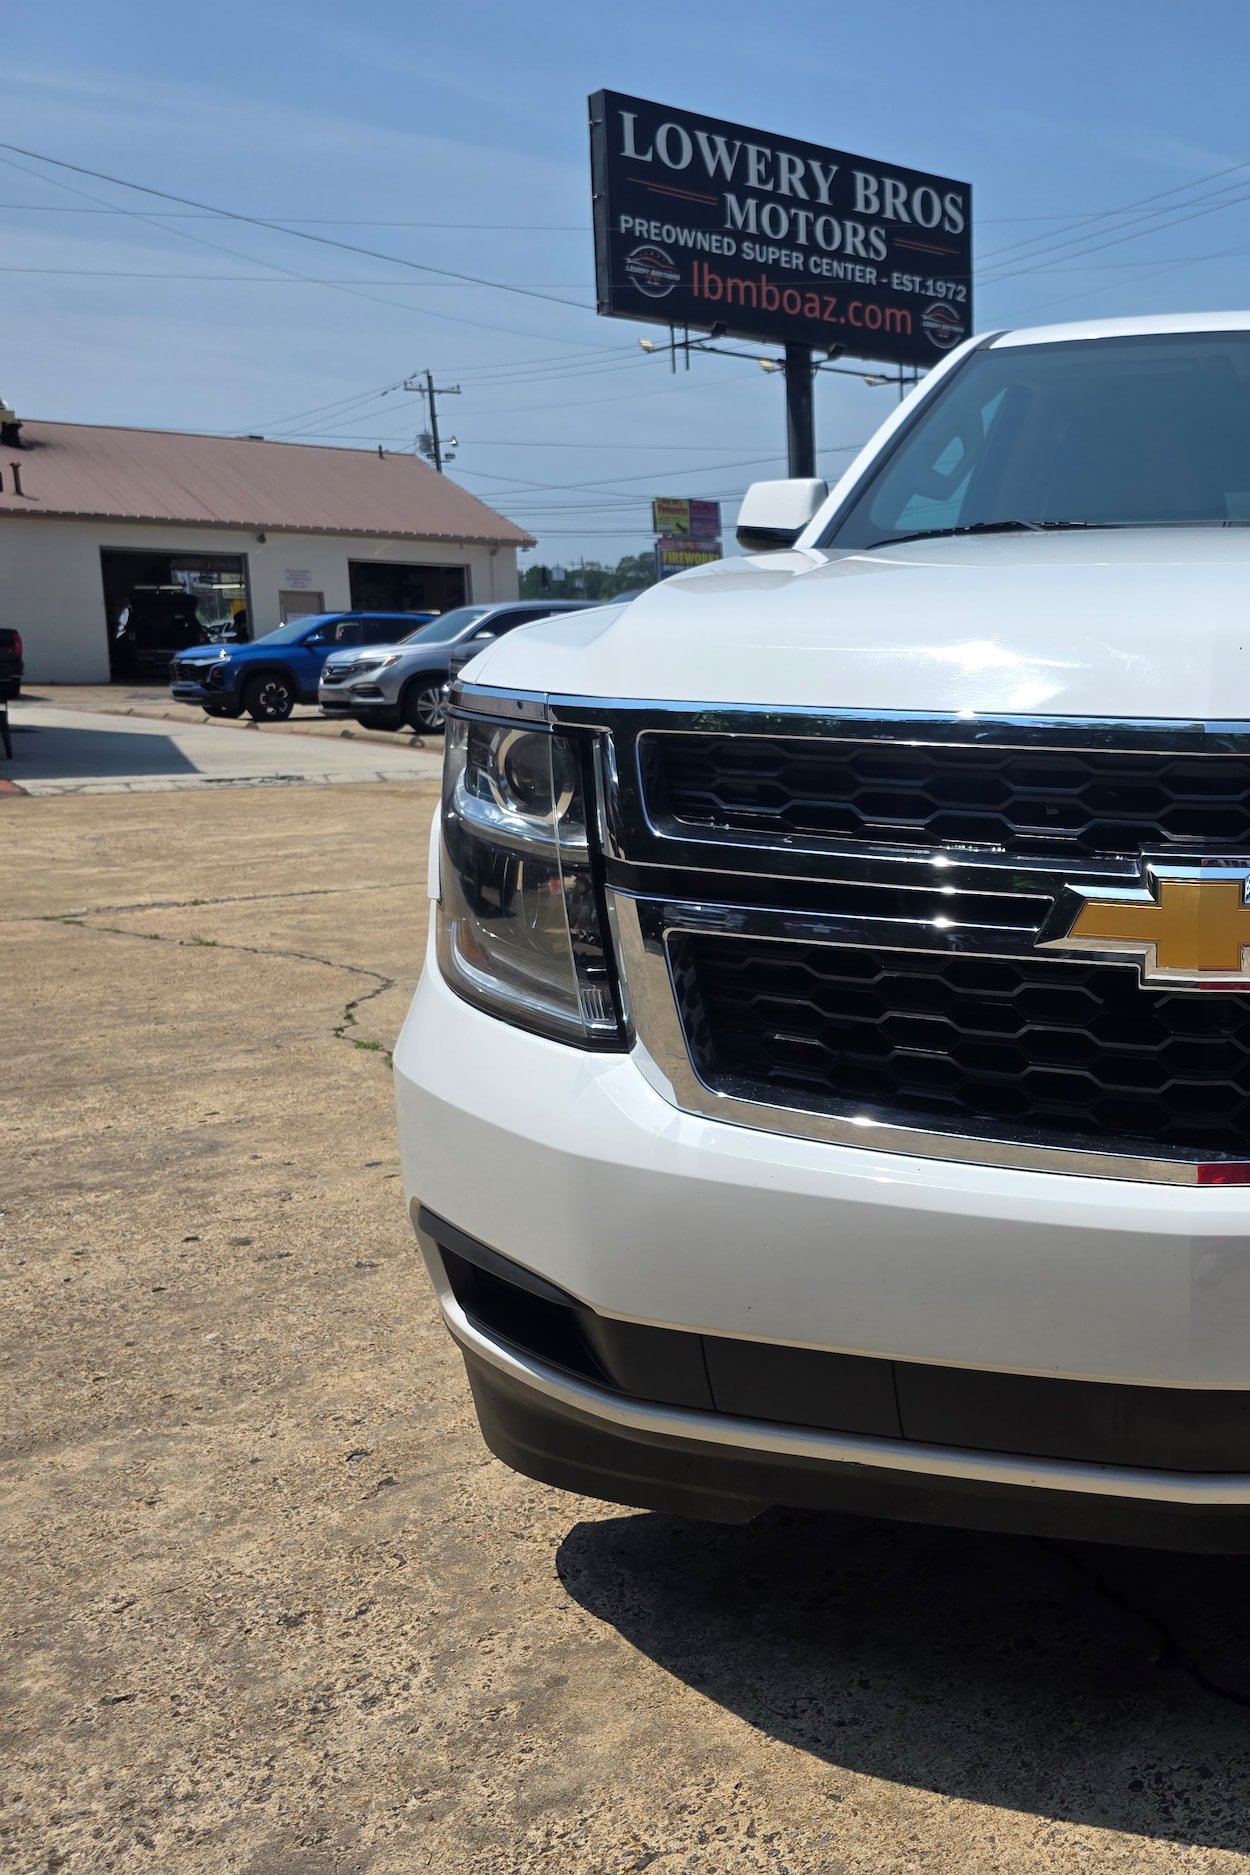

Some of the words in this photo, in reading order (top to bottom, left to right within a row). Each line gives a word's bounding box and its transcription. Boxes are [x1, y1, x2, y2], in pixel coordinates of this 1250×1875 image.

[618, 110, 839, 206] LOWERY
[851, 171, 965, 234] BROS
[620, 214, 737, 257] PREOWNED
[741, 241, 804, 272] SUPER
[809, 256, 877, 287] CENTER
[891, 272, 967, 303] EST.1972
[722, 193, 888, 262] MOTORS
[692, 260, 912, 335] lbmboaz.com
